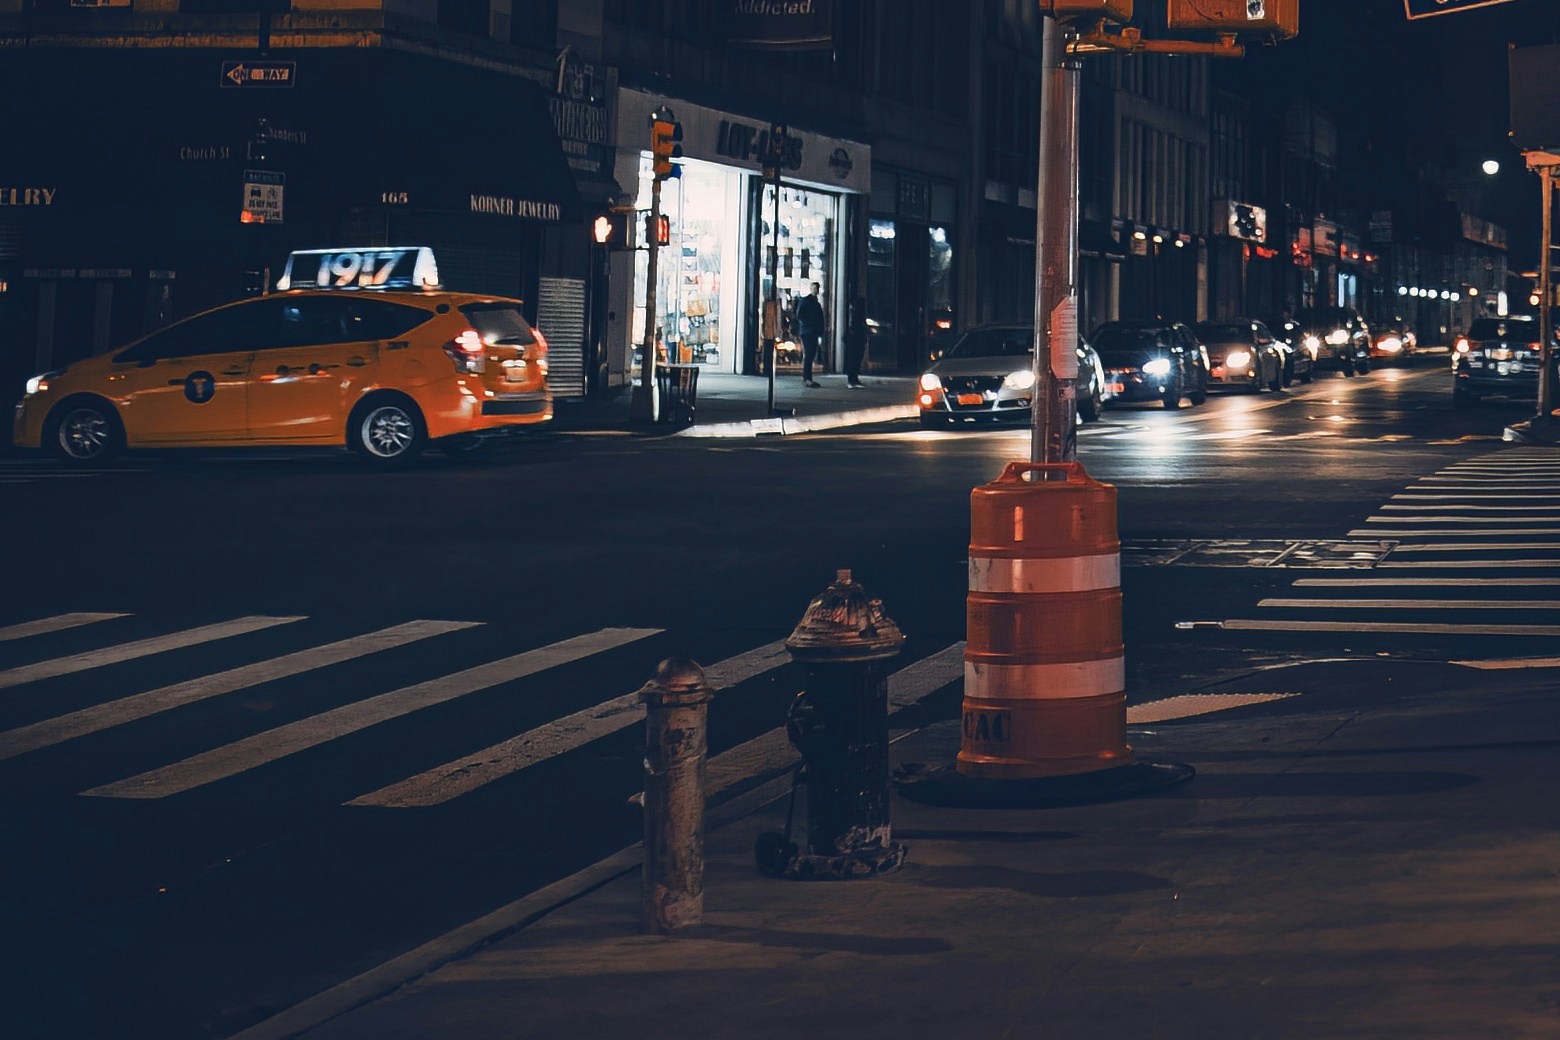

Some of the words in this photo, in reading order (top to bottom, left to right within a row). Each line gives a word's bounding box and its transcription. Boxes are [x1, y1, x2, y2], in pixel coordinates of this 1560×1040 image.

[268, 127, 298, 142] hambers
[180, 146, 216, 161] Church
[470, 193, 514, 217] KORNER
[518, 199, 561, 221] JEWELRY
[317, 251, 407, 287] 1917
